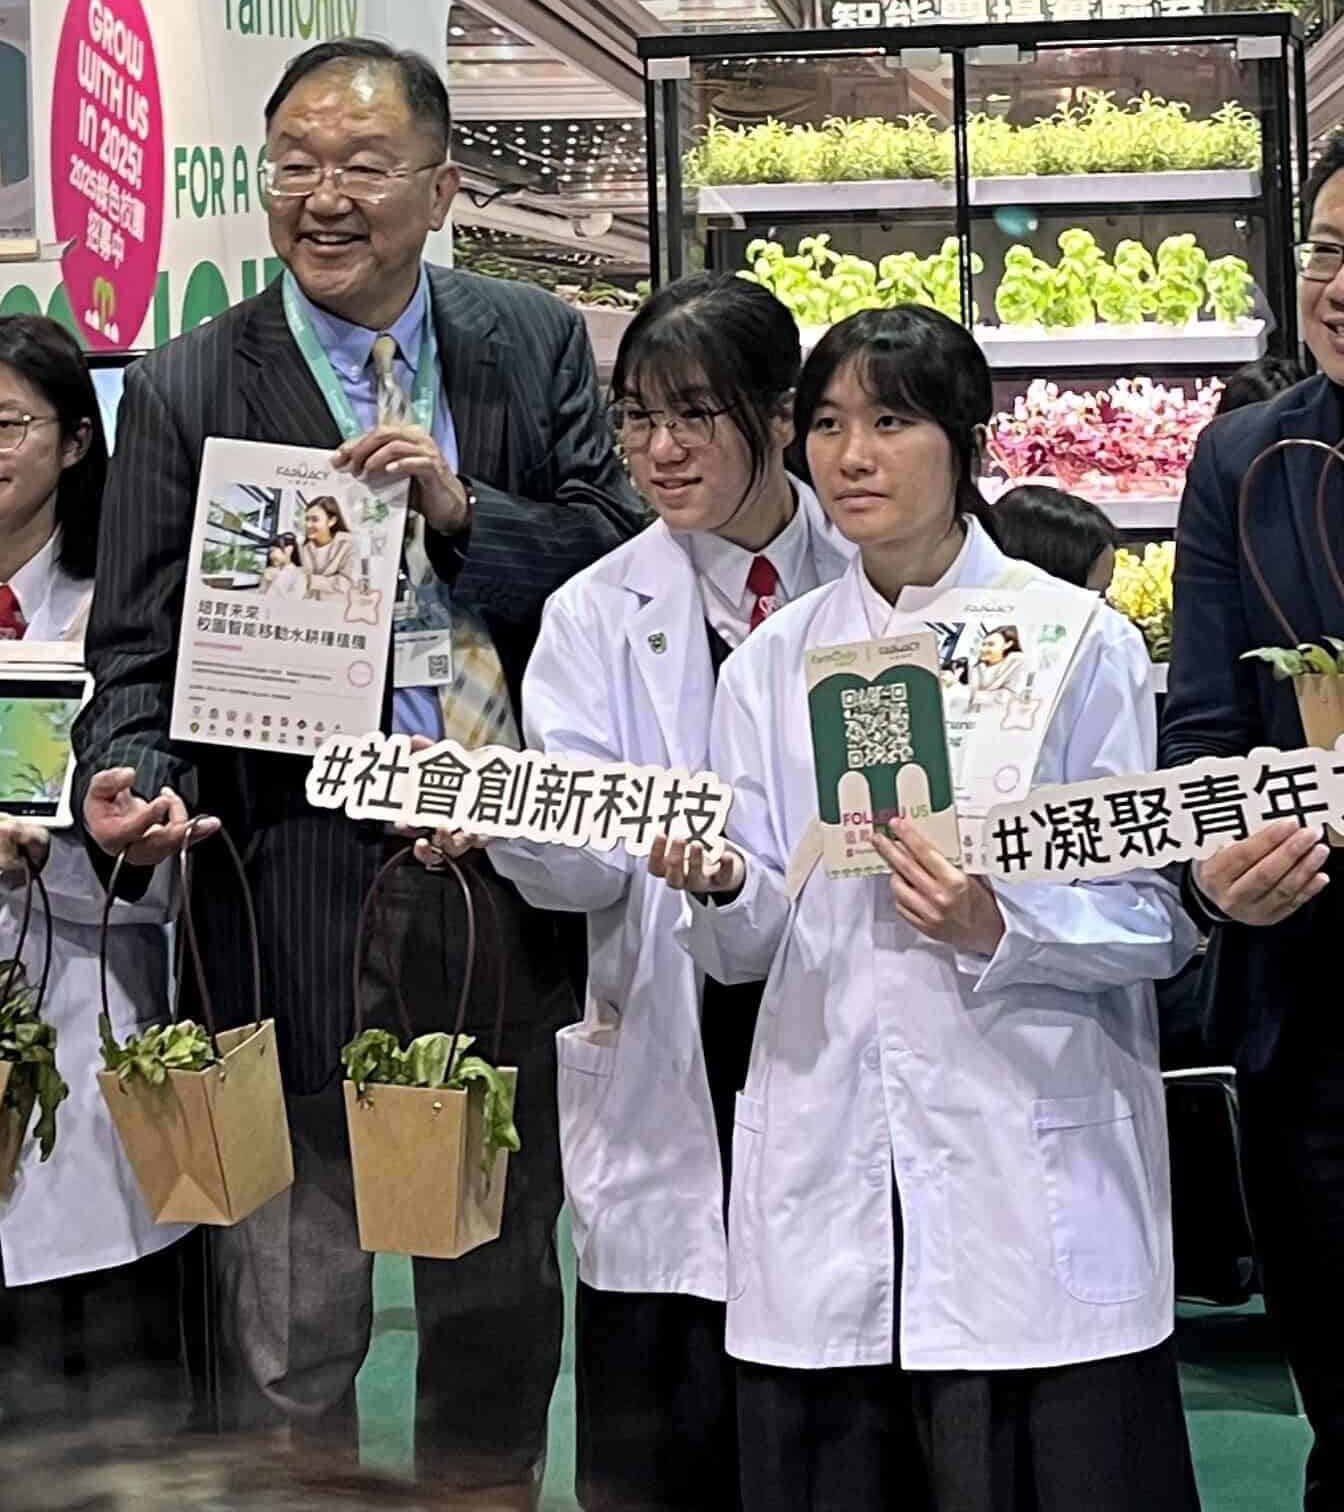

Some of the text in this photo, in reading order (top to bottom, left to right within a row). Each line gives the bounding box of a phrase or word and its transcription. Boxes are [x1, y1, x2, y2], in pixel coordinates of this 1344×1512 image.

[77, 40, 150, 140] WITH US
[78, 99, 144, 190] IN 2025!
[175, 144, 227, 219] FOR
[233, 143, 250, 214] A
[316, 742, 723, 853] #社會創新科技
